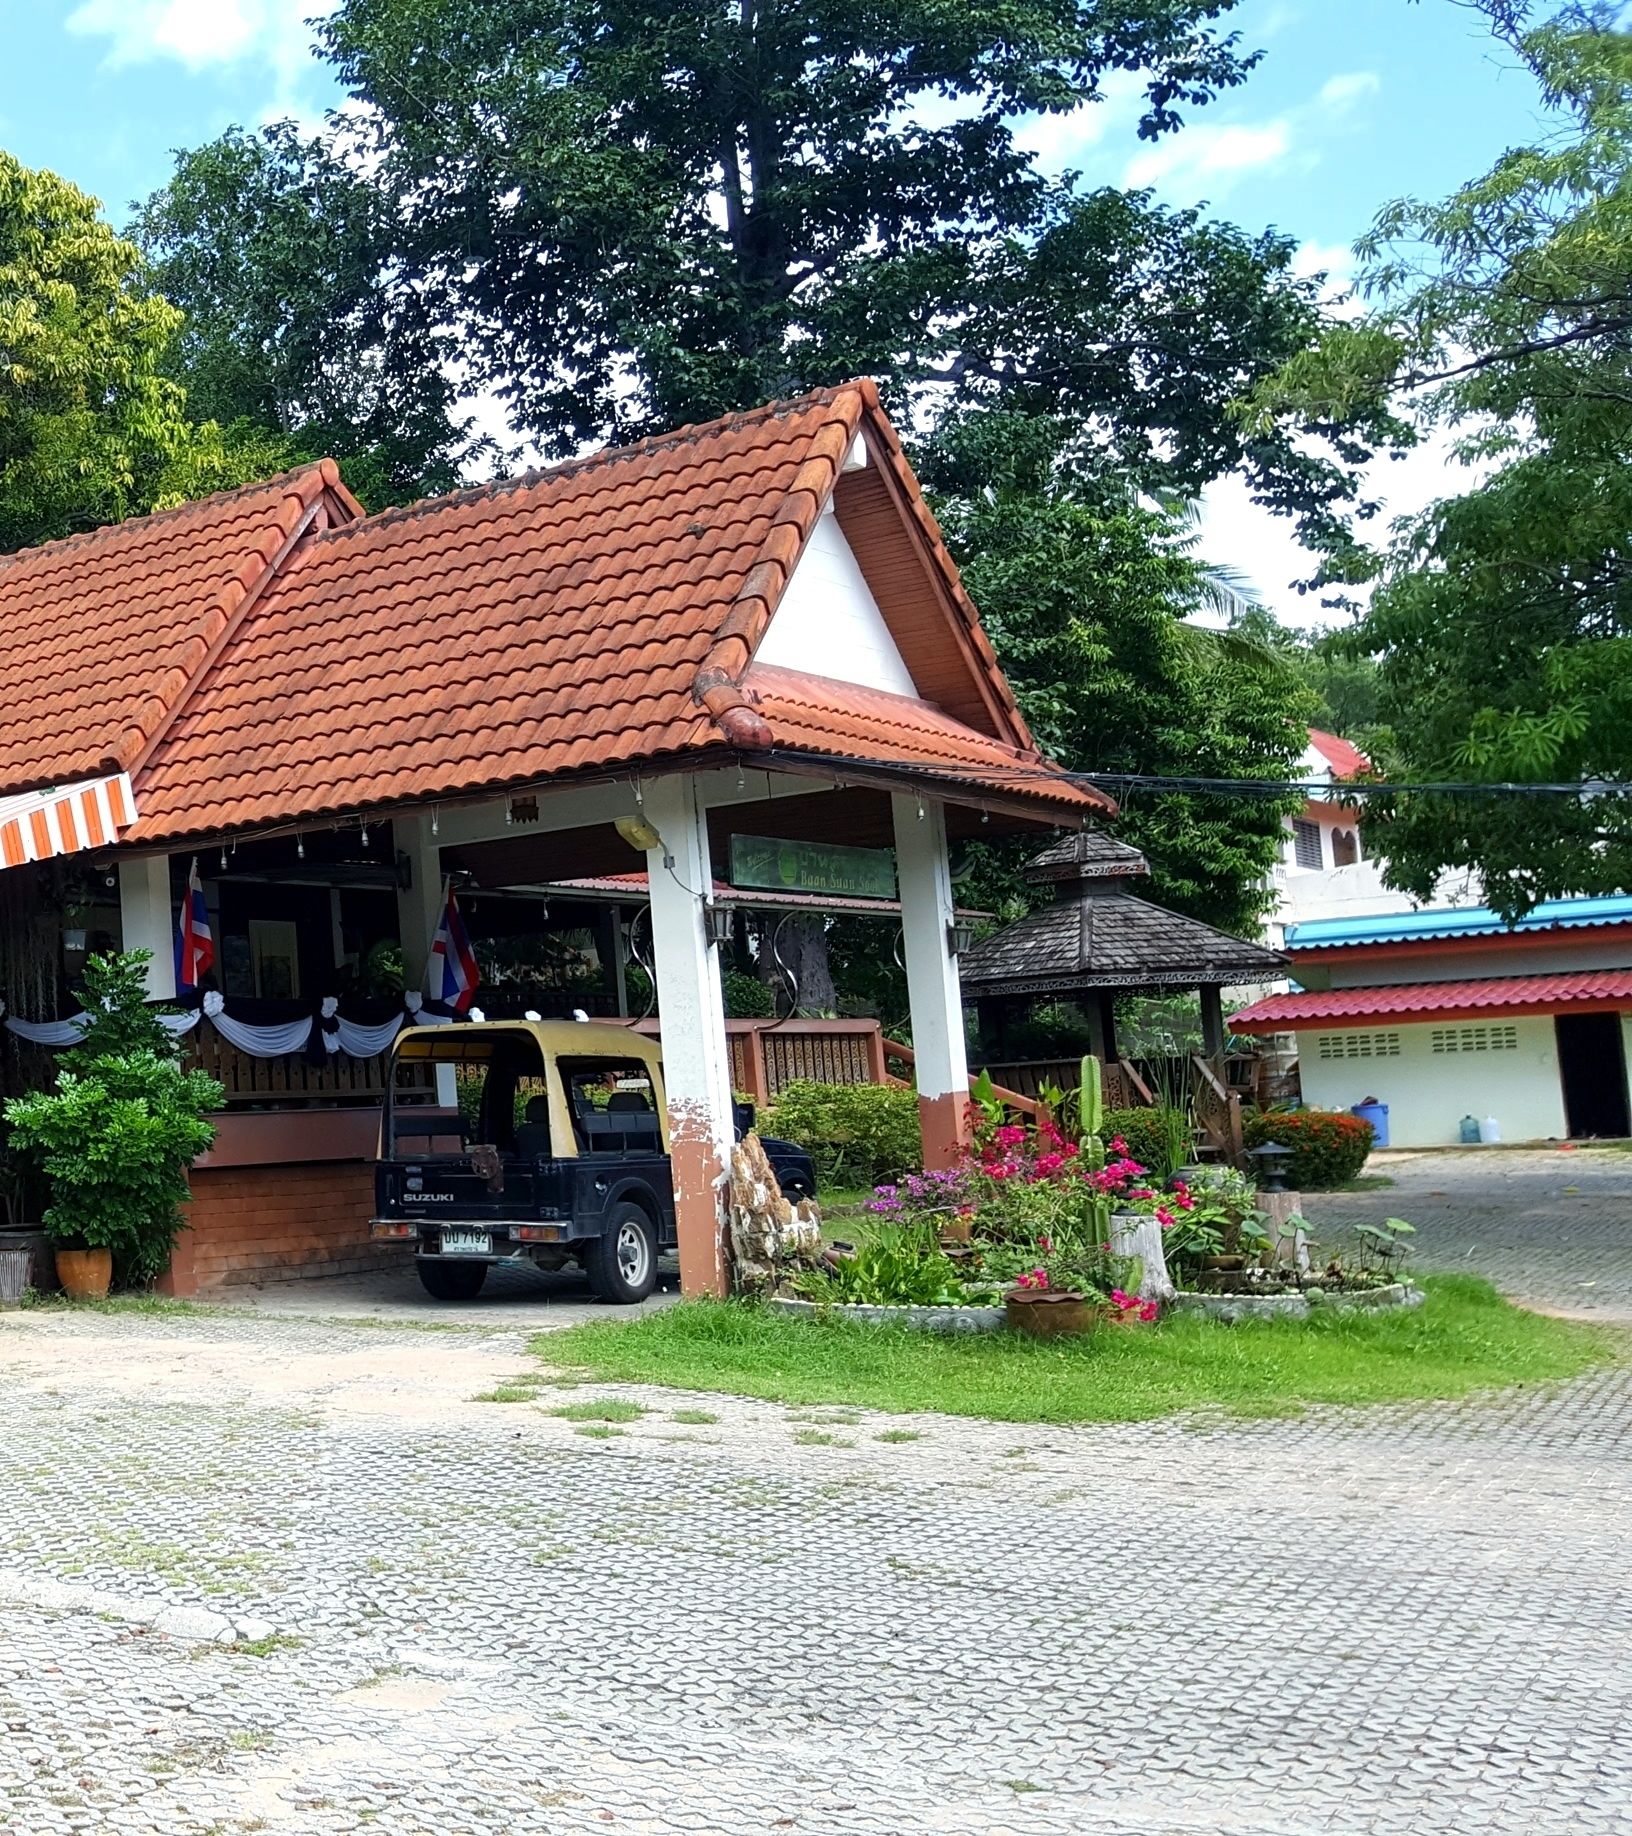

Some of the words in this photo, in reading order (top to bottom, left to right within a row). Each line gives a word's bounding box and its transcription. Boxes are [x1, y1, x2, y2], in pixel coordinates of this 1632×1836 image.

[801, 870, 826, 888] Baan
[830, 873, 855, 890] Suan
[403, 1193, 454, 1202] SUZUKI
[463, 1231, 487, 1243] 7192
